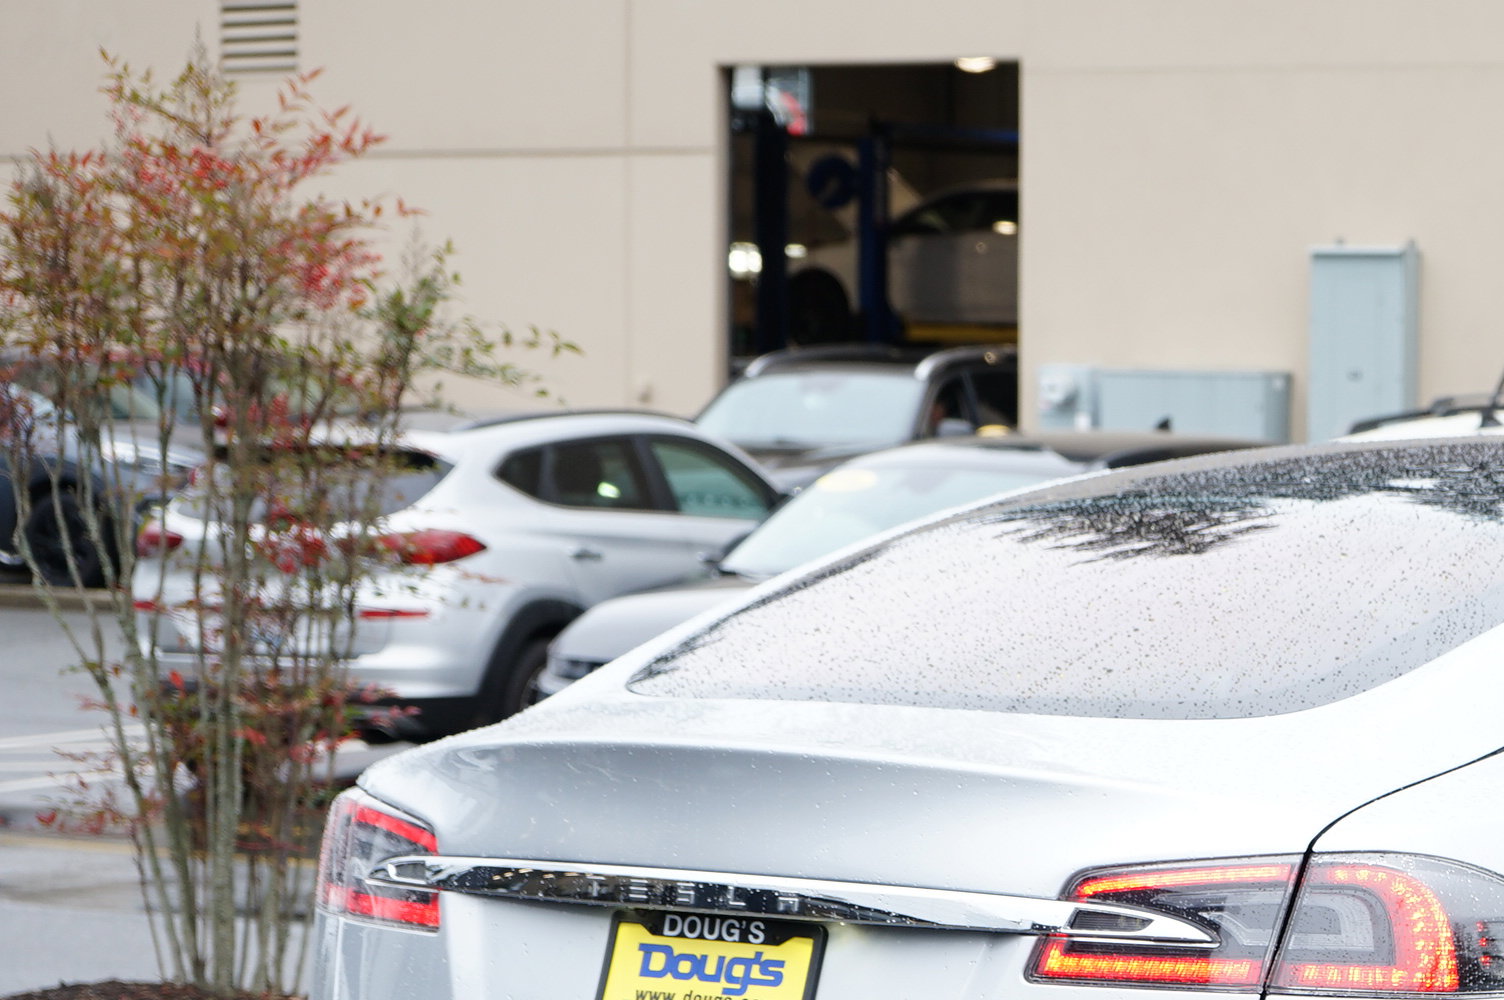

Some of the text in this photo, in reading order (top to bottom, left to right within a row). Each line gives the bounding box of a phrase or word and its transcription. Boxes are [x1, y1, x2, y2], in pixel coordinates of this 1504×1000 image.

[585, 875, 800, 913] TESLA
[663, 915, 766, 944] DOUG'S
[638, 942, 785, 996] Doug's
